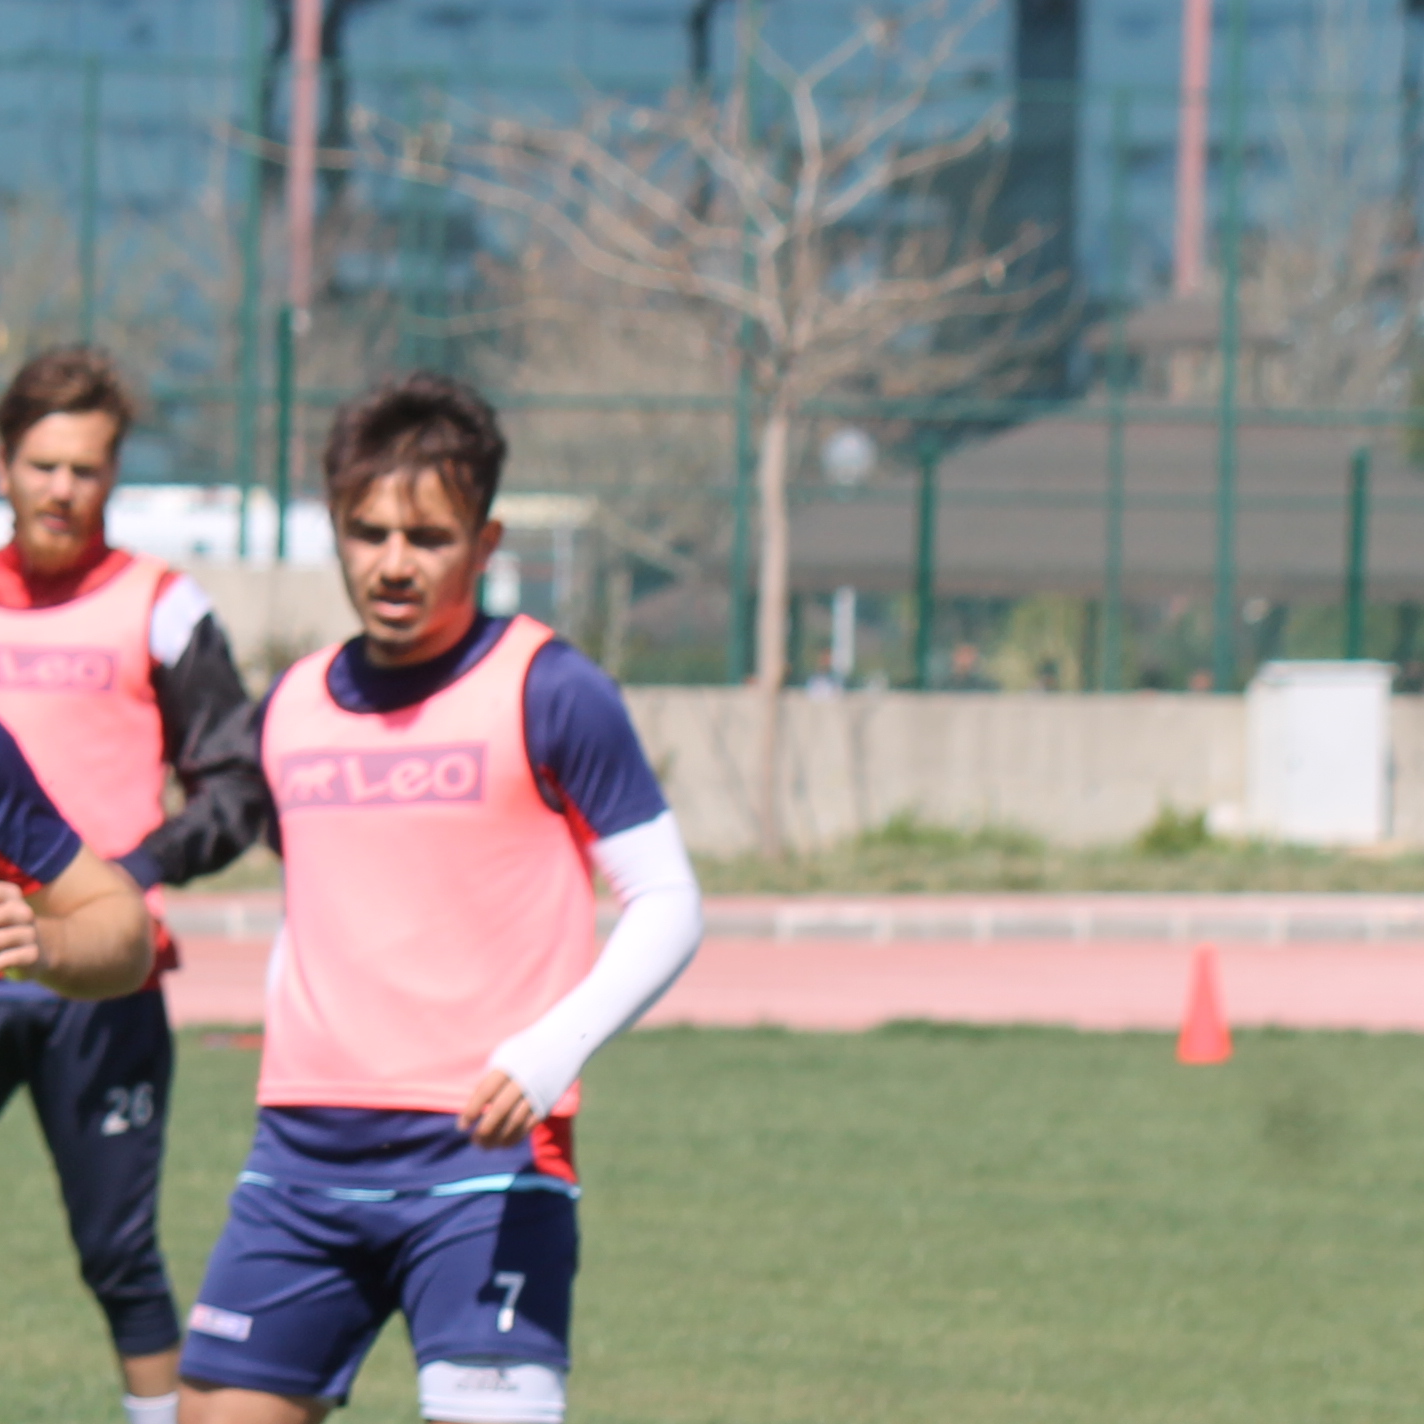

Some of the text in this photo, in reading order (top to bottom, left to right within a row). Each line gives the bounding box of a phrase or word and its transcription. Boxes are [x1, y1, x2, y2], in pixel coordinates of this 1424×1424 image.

[342, 752, 479, 803] Leo
[100, 1083, 154, 1136] 26
[494, 1271, 526, 1333] 7
